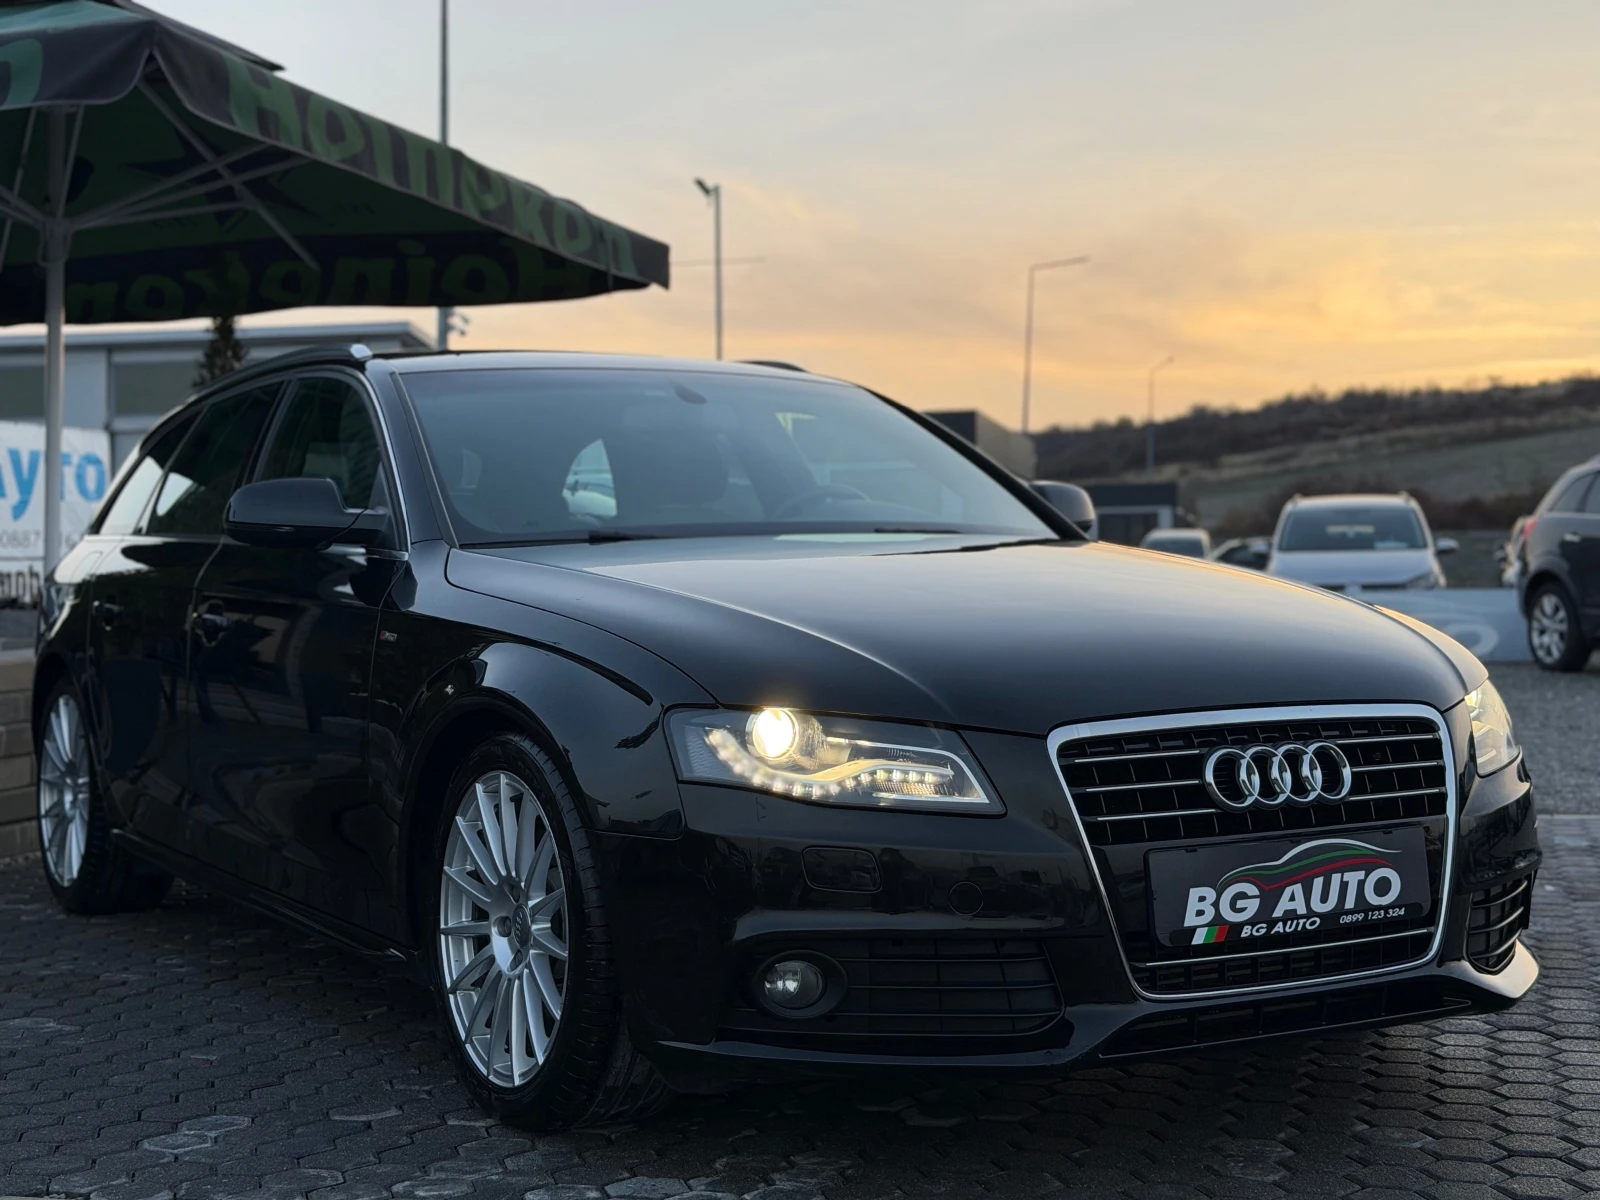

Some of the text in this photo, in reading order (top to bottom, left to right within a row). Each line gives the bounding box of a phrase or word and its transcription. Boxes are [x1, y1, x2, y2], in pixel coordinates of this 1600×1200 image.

[1183, 867, 1401, 927] BG AUTO
[1339, 907, 1405, 924] 0899 123 324
[1240, 917, 1321, 938] BG AUTO
